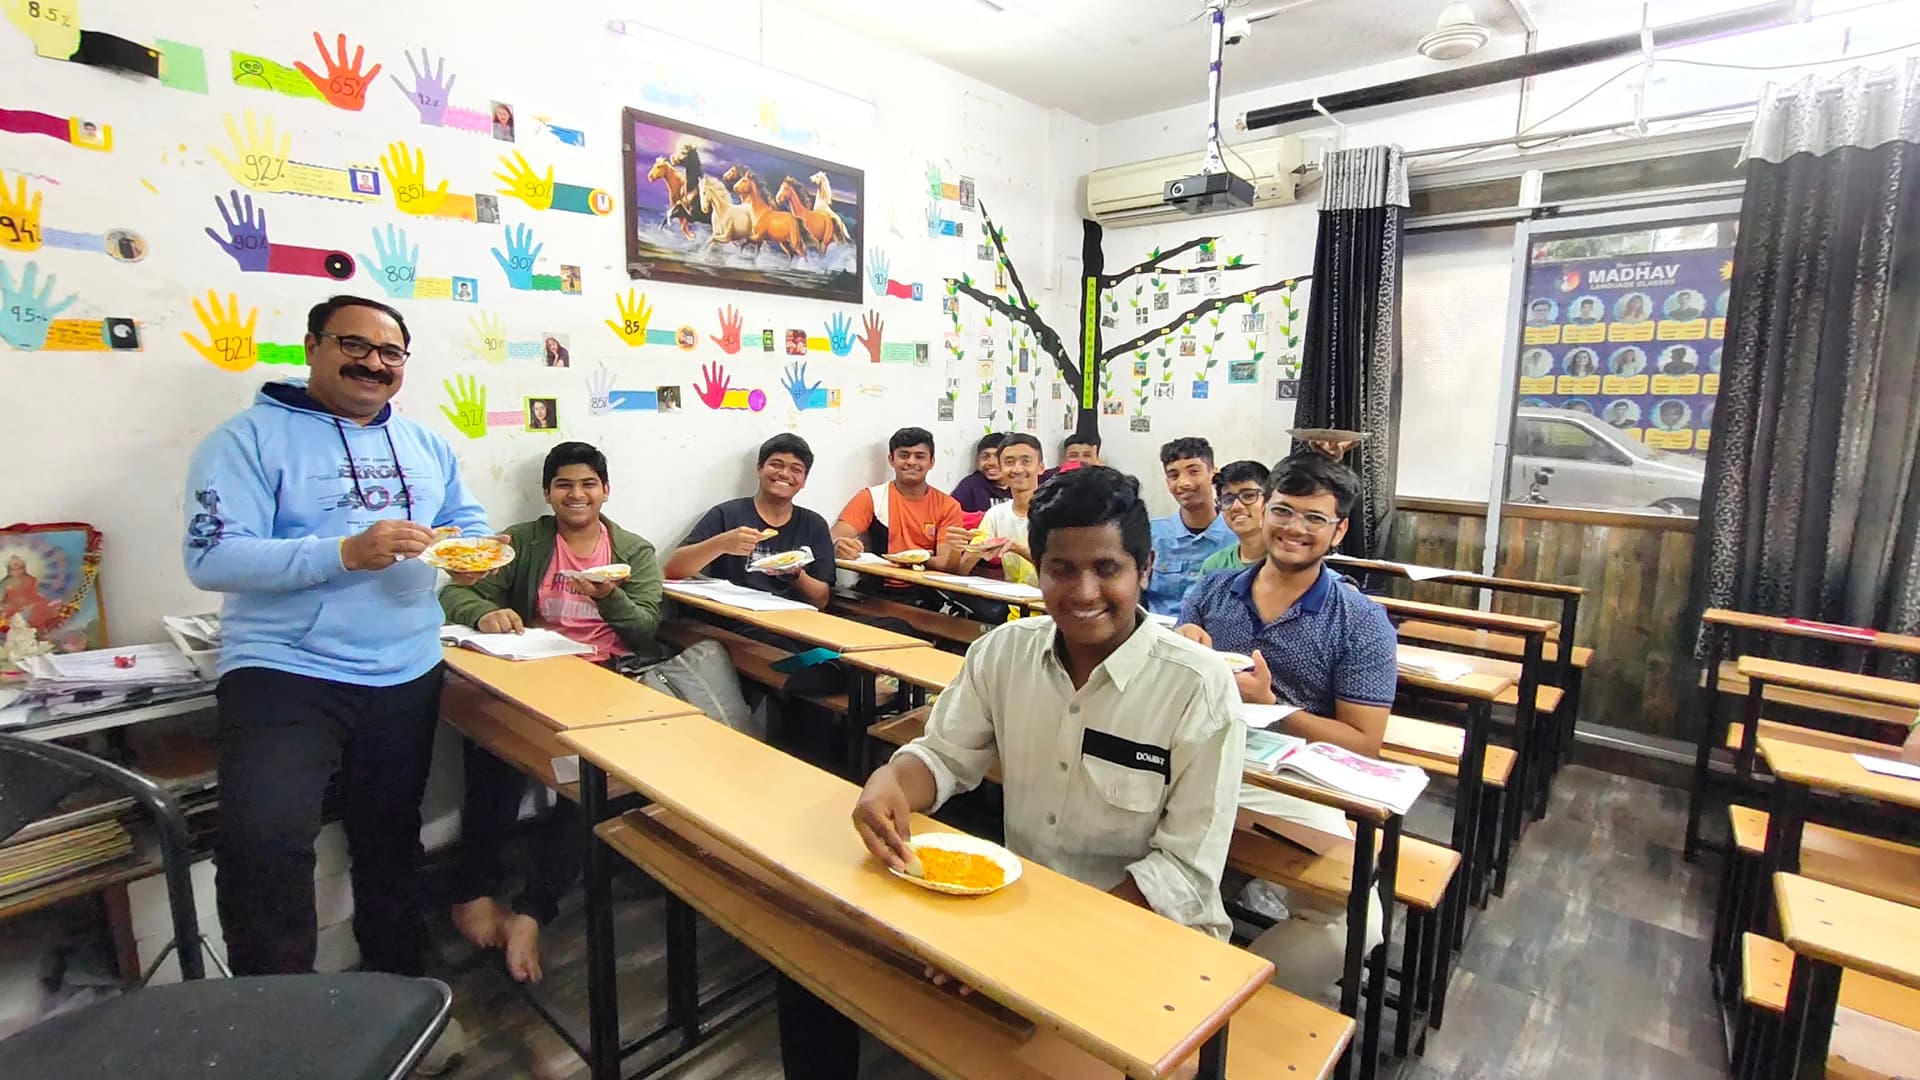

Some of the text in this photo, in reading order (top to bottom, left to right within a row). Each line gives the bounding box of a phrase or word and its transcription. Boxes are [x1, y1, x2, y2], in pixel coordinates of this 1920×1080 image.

[330, 75, 366, 99] 65%
[244, 154, 285, 181] 92%
[384, 265, 416, 282] 80%
[1588, 263, 1681, 284] MADHAV
